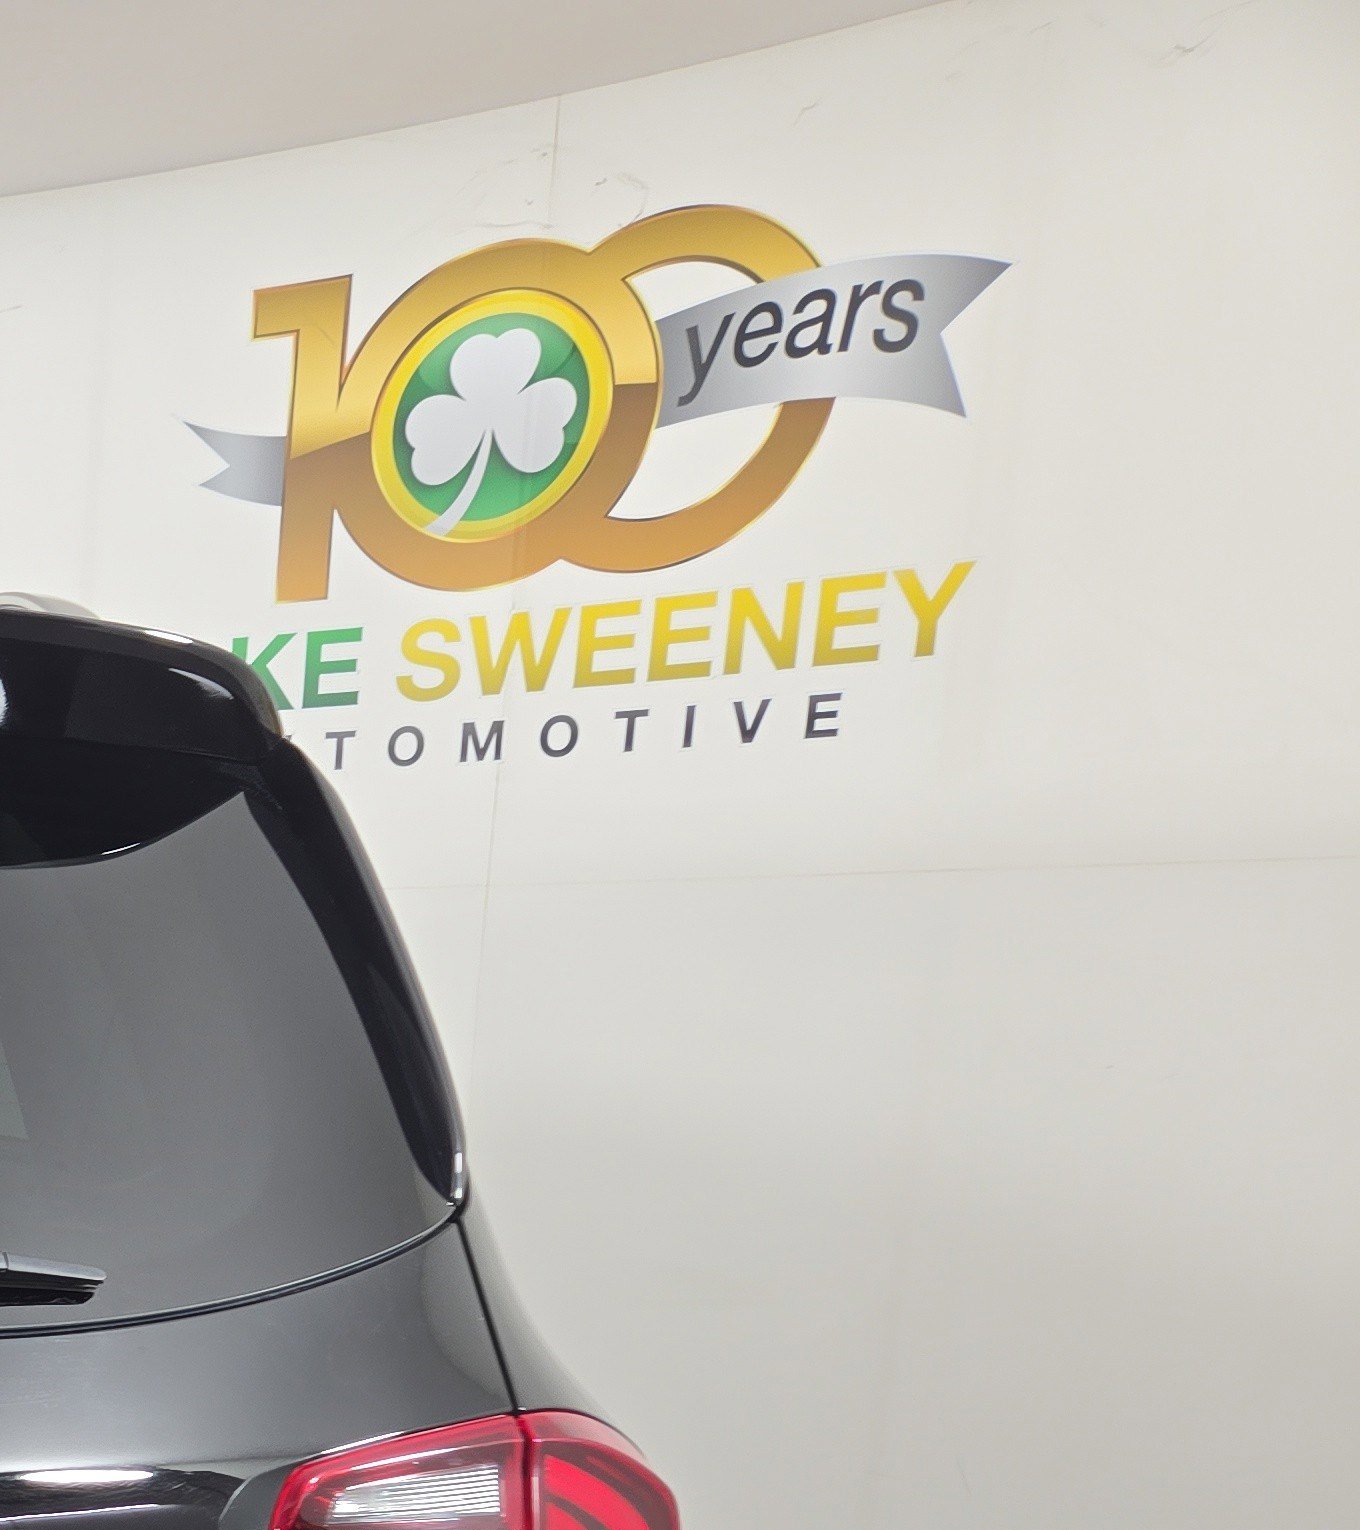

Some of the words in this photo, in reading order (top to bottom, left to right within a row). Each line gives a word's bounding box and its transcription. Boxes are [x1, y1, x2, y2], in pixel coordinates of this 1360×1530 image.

[253, 204, 837, 603] 100
[678, 277, 926, 407] years
[231, 627, 363, 711] KE
[395, 561, 978, 703] SWEENEY
[284, 692, 844, 771] TOMOTIVE
